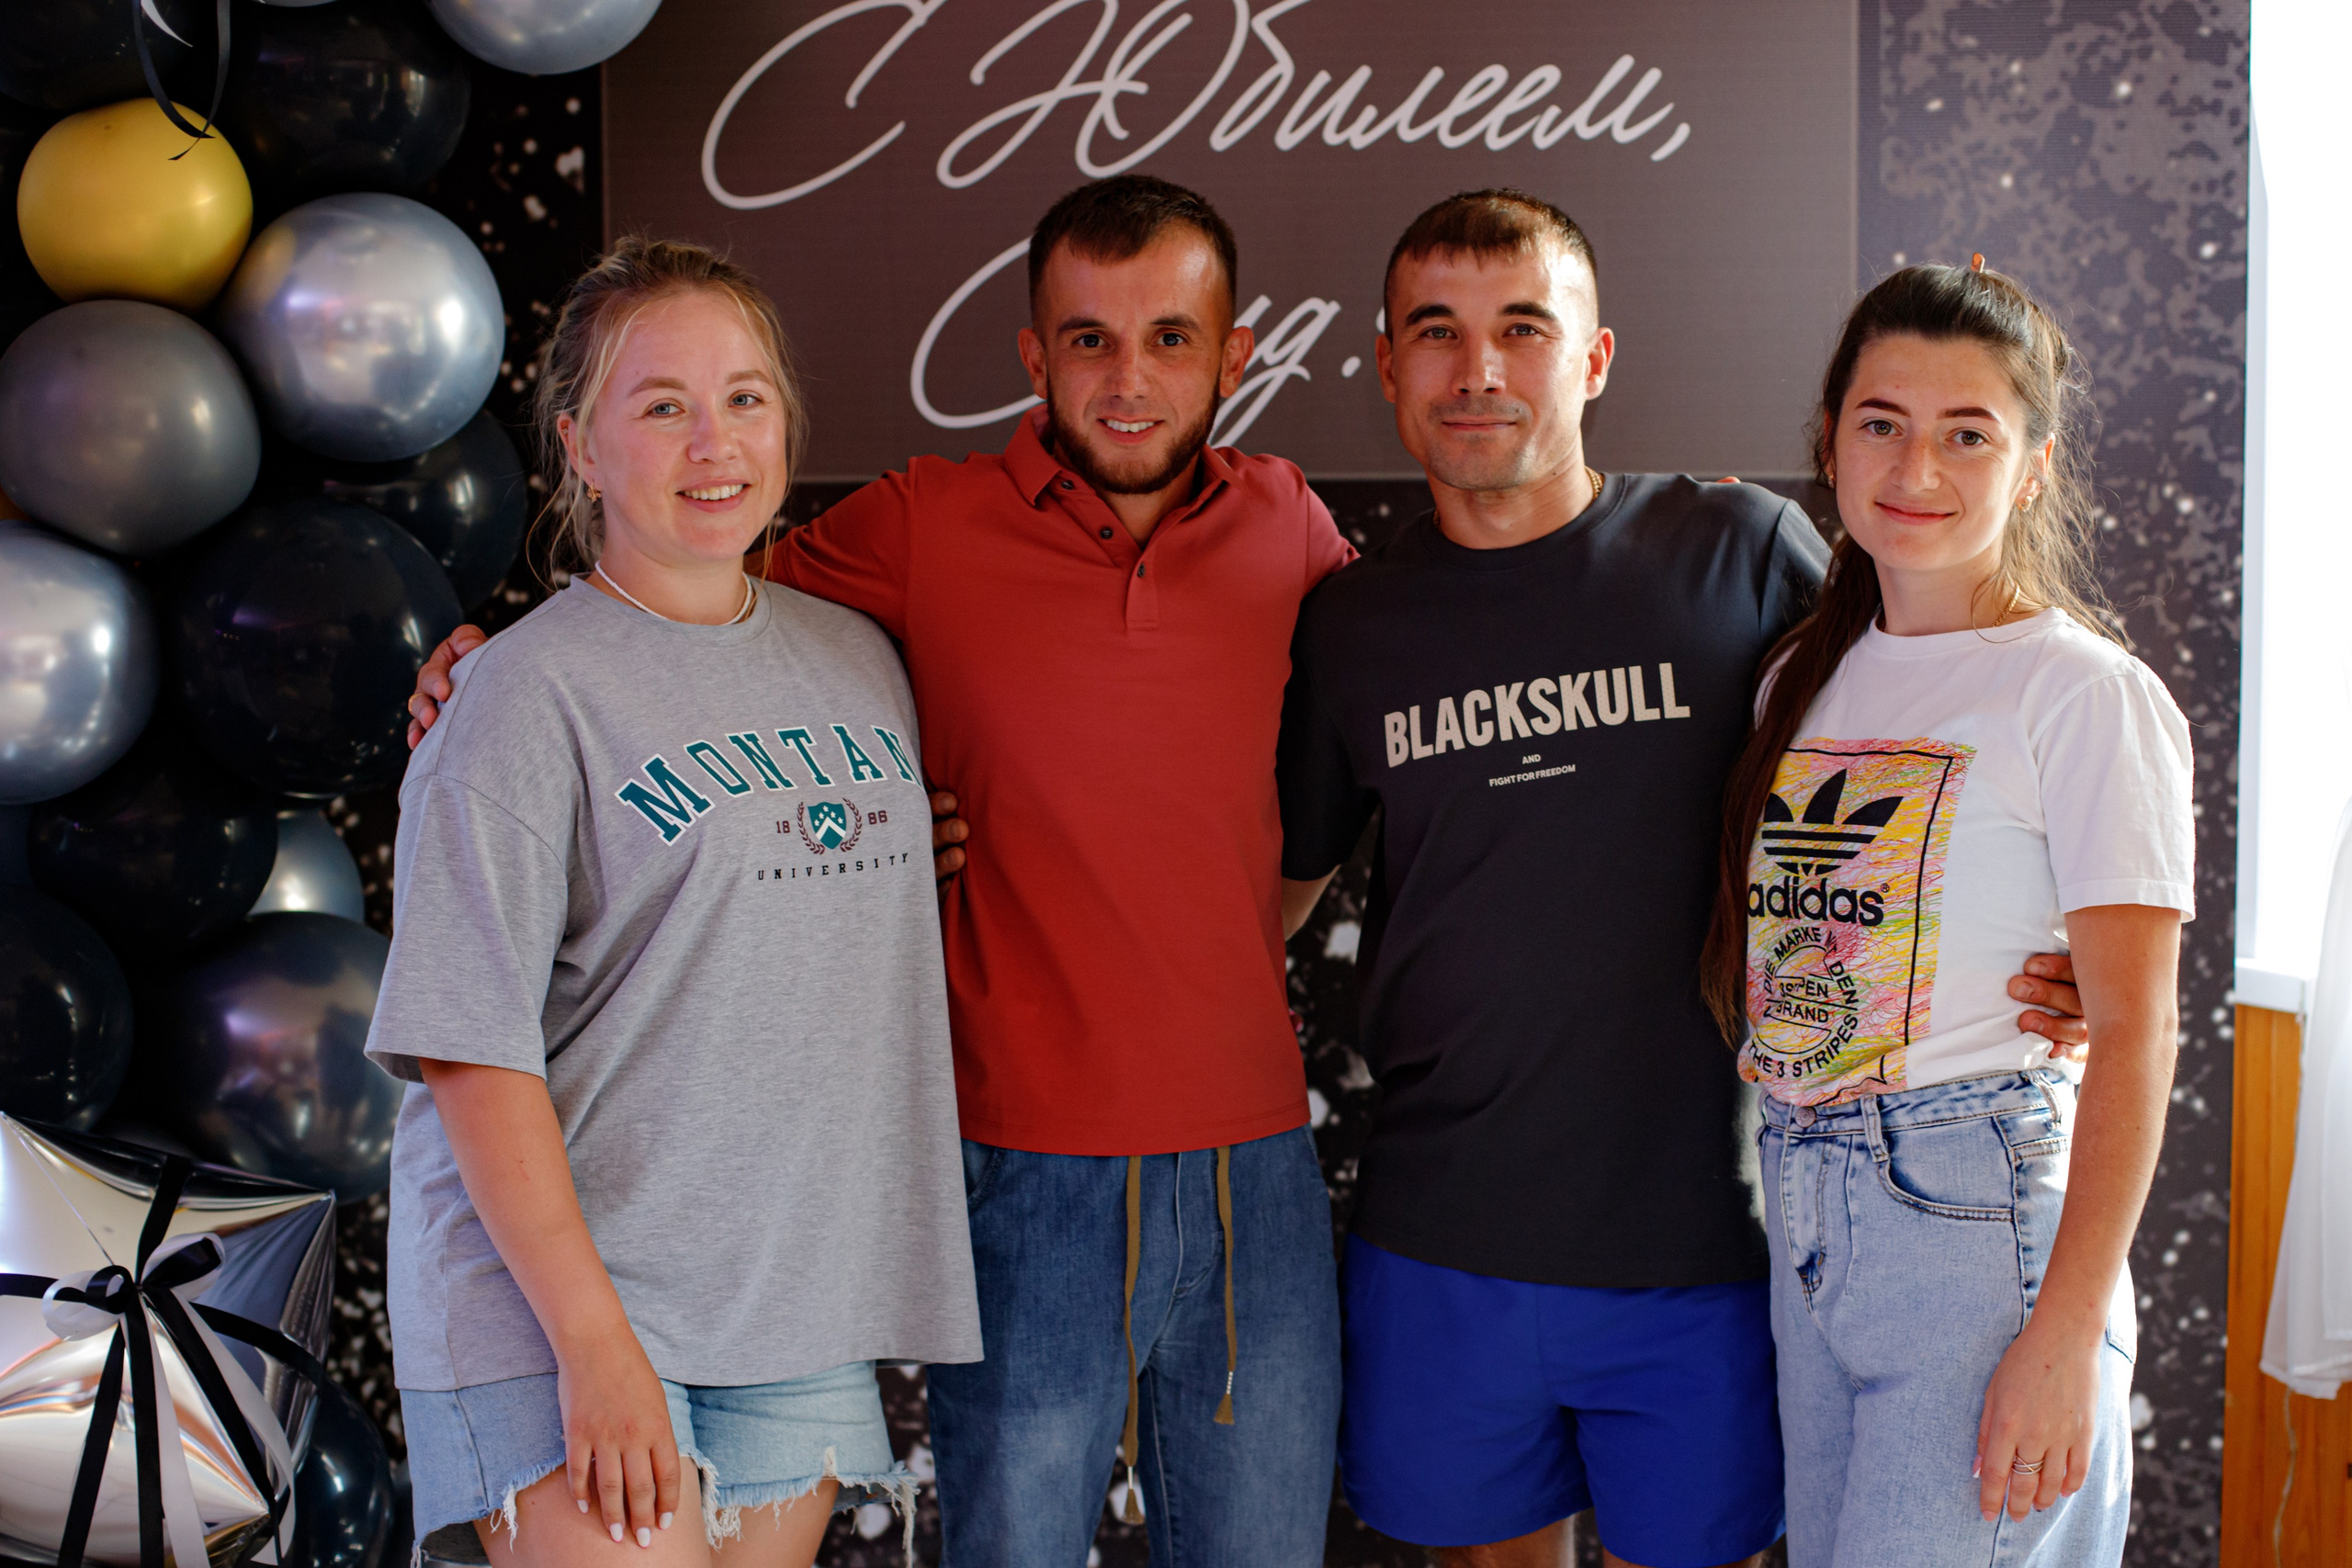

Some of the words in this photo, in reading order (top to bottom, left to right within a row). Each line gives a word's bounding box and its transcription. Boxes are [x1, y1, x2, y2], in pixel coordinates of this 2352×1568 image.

[1384, 662, 1690, 768] BLACKSKULL
[1521, 754, 1542, 764] AND
[1489, 775, 1517, 787] FIGHT
[1517, 772, 1535, 783] FOR
[1535, 764, 1577, 779] FREEDOM
[775, 820, 791, 834] 18
[867, 810, 888, 825] 86
[757, 852, 909, 881] UNIVERSITY
[1763, 959, 1776, 995] DIE
[1773, 926, 1822, 962] MARKE
[1829, 961, 1860, 1005] DEN
[1748, 1039, 1772, 1074] THE
[1777, 1061, 1784, 1077] 3
[1792, 1014, 1859, 1077] STRIPES
